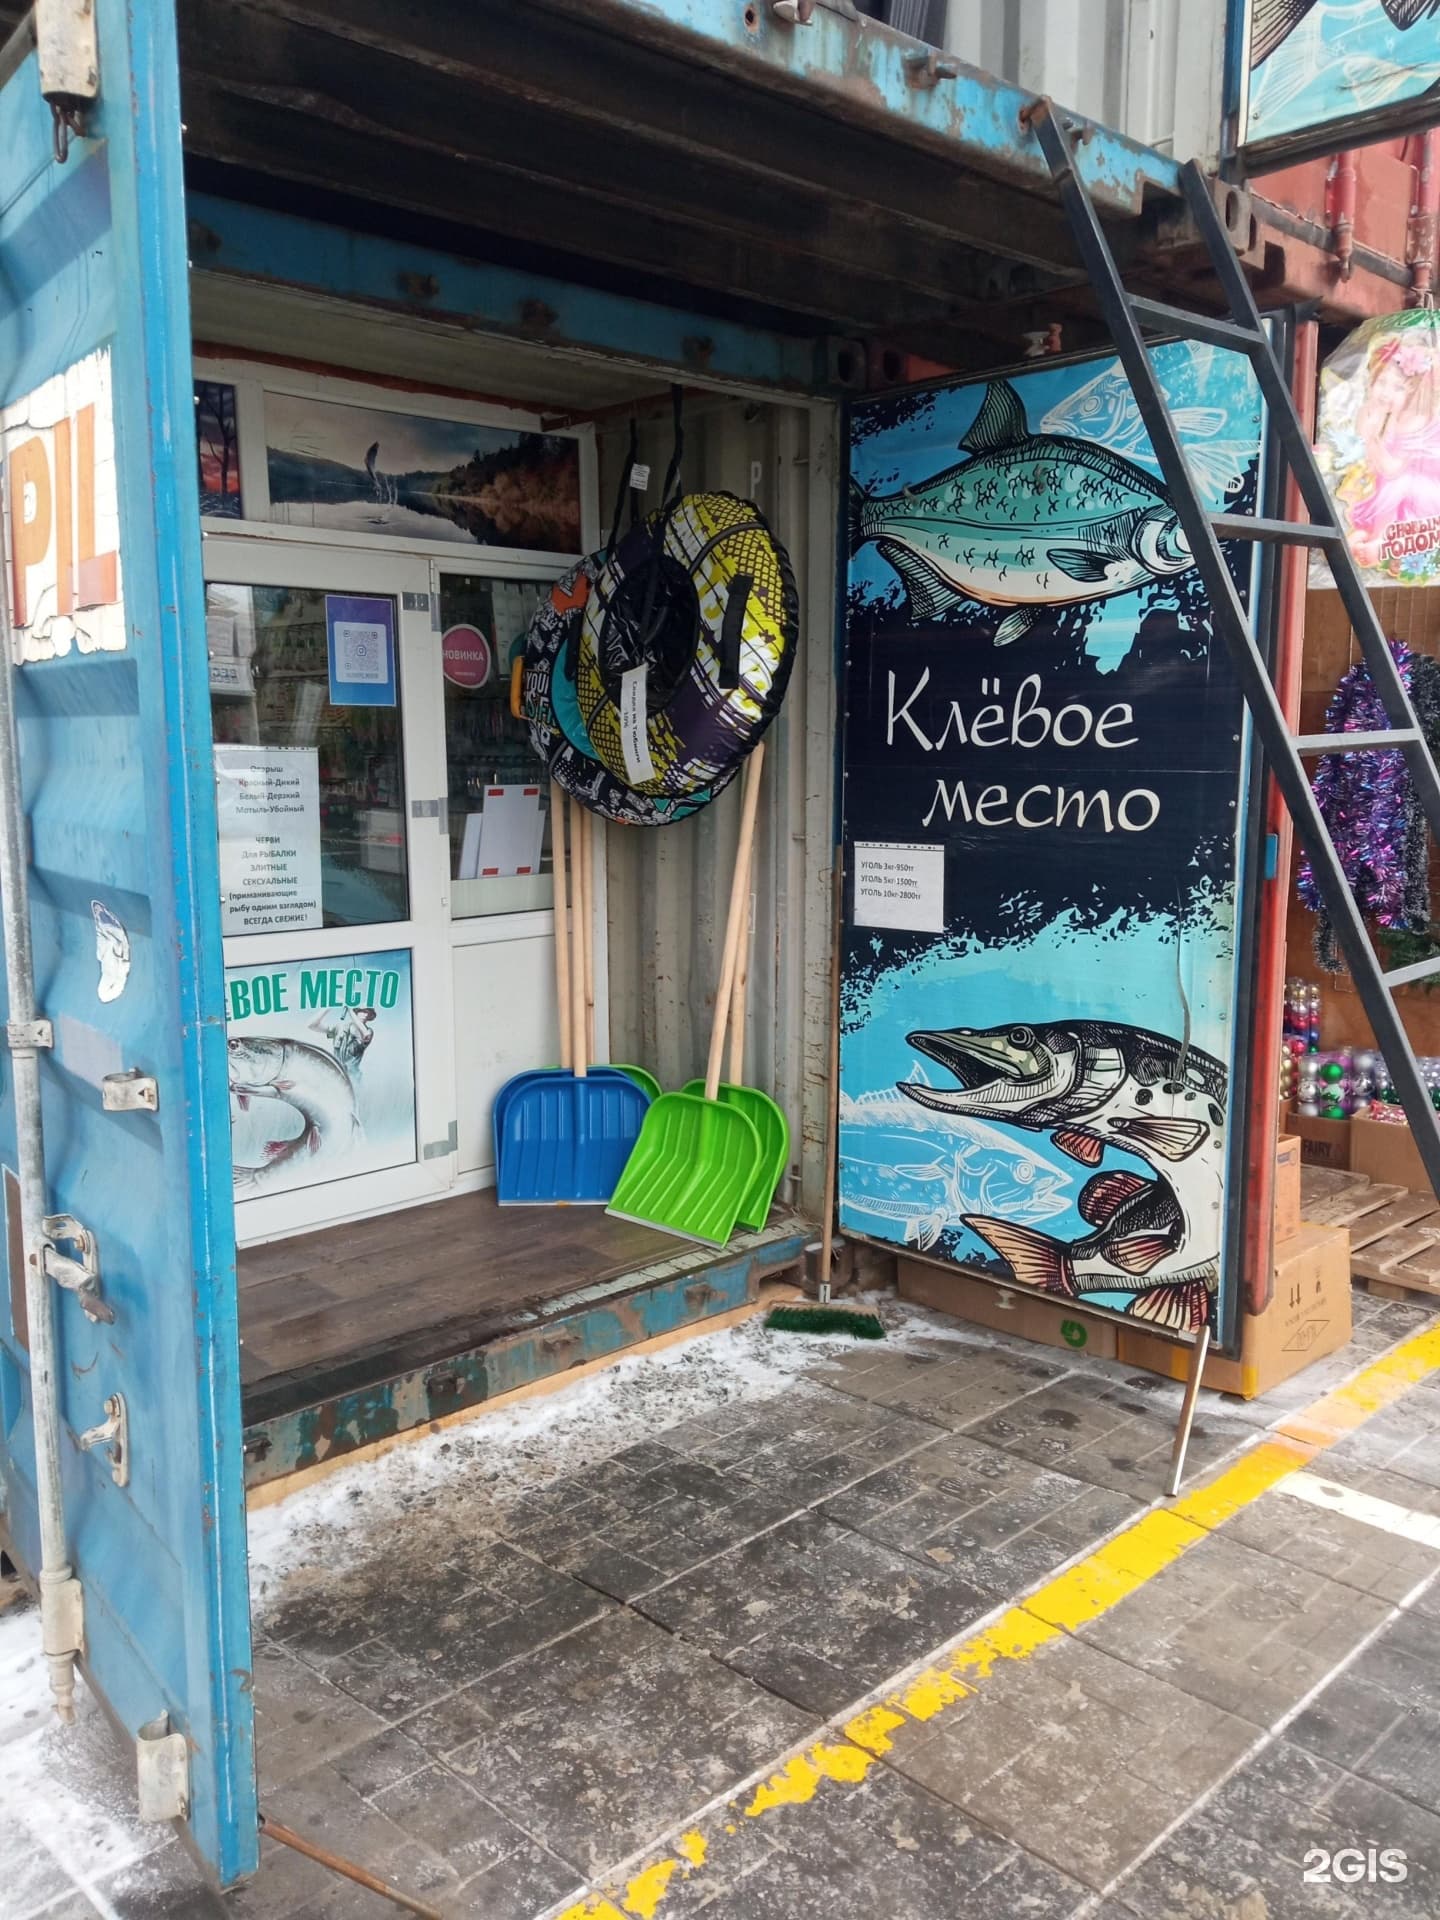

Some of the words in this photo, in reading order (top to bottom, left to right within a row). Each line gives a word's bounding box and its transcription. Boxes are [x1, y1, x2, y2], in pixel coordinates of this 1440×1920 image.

[1381, 530, 1440, 559] ГОДОМ
[441, 649, 484, 661] НОВИНКА
[886, 666, 1139, 752] Клёвое
[239, 791, 300, 800] Белый-Дерзкий
[235, 804, 304, 814] Мотыль-Убойный
[921, 778, 1160, 833] место
[255, 836, 280, 844] ЧЕРВИ
[259, 849, 297, 858] РЫБАЛКИ
[861, 861, 882, 870] УГОЛЬ
[242, 876, 298, 886] СЕКСУАЛЬНЫЕ
[860, 875, 882, 883] УГОЛЬ
[860, 888, 882, 897] УГОЛЬ
[229, 904, 250, 914] рыбу
[251, 903, 277, 912] одним
[243, 916, 273, 925] ВСЕГДА
[274, 913, 308, 923] СВЕЖИЕ!
[224, 973, 289, 1022] ВОЕ
[300, 968, 400, 1010] МЕСТО
